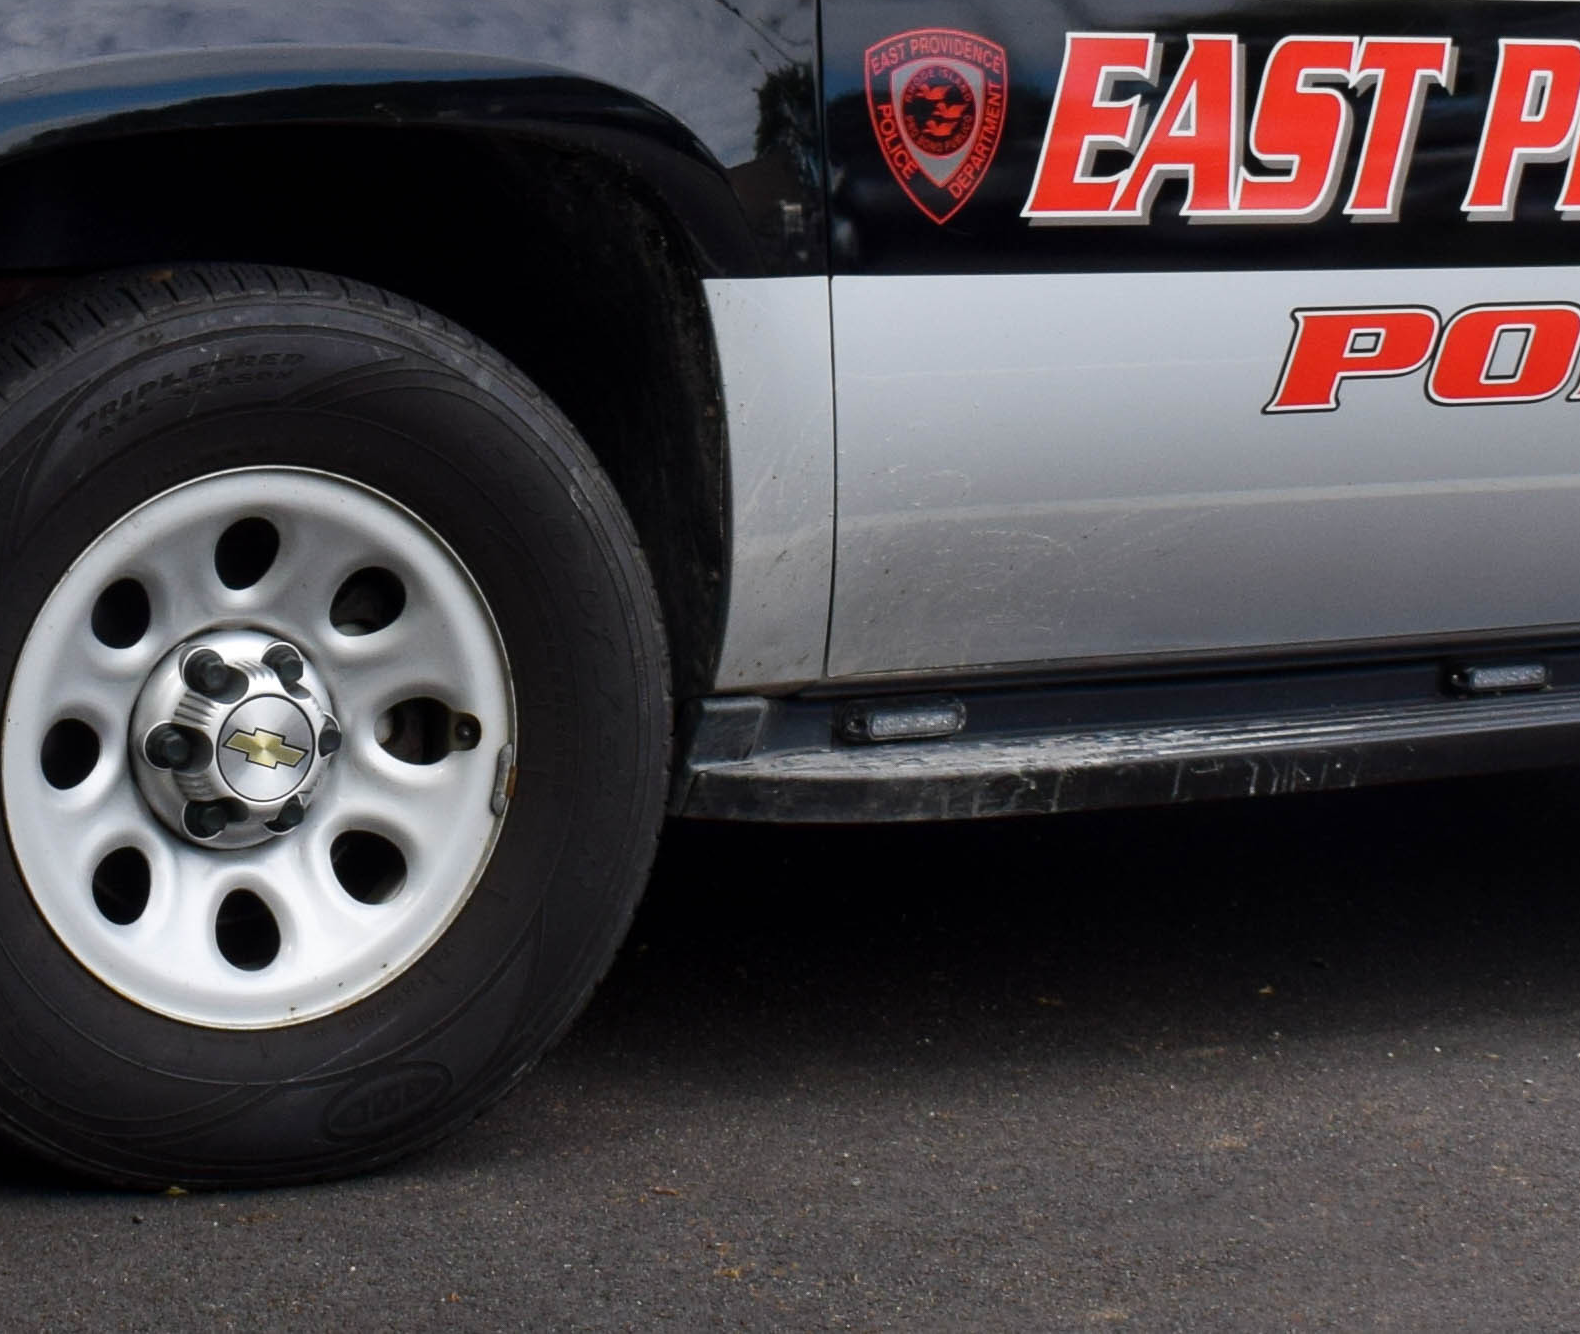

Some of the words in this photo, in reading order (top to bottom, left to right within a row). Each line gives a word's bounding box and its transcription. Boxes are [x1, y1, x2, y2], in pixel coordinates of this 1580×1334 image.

[871, 43, 907, 76] EAST
[909, 37, 1003, 74] PROVIDENCE
[877, 104, 919, 180] POLICE
[948, 81, 1001, 199] DEPARTMENT
[1019, 32, 1459, 226] EAST
